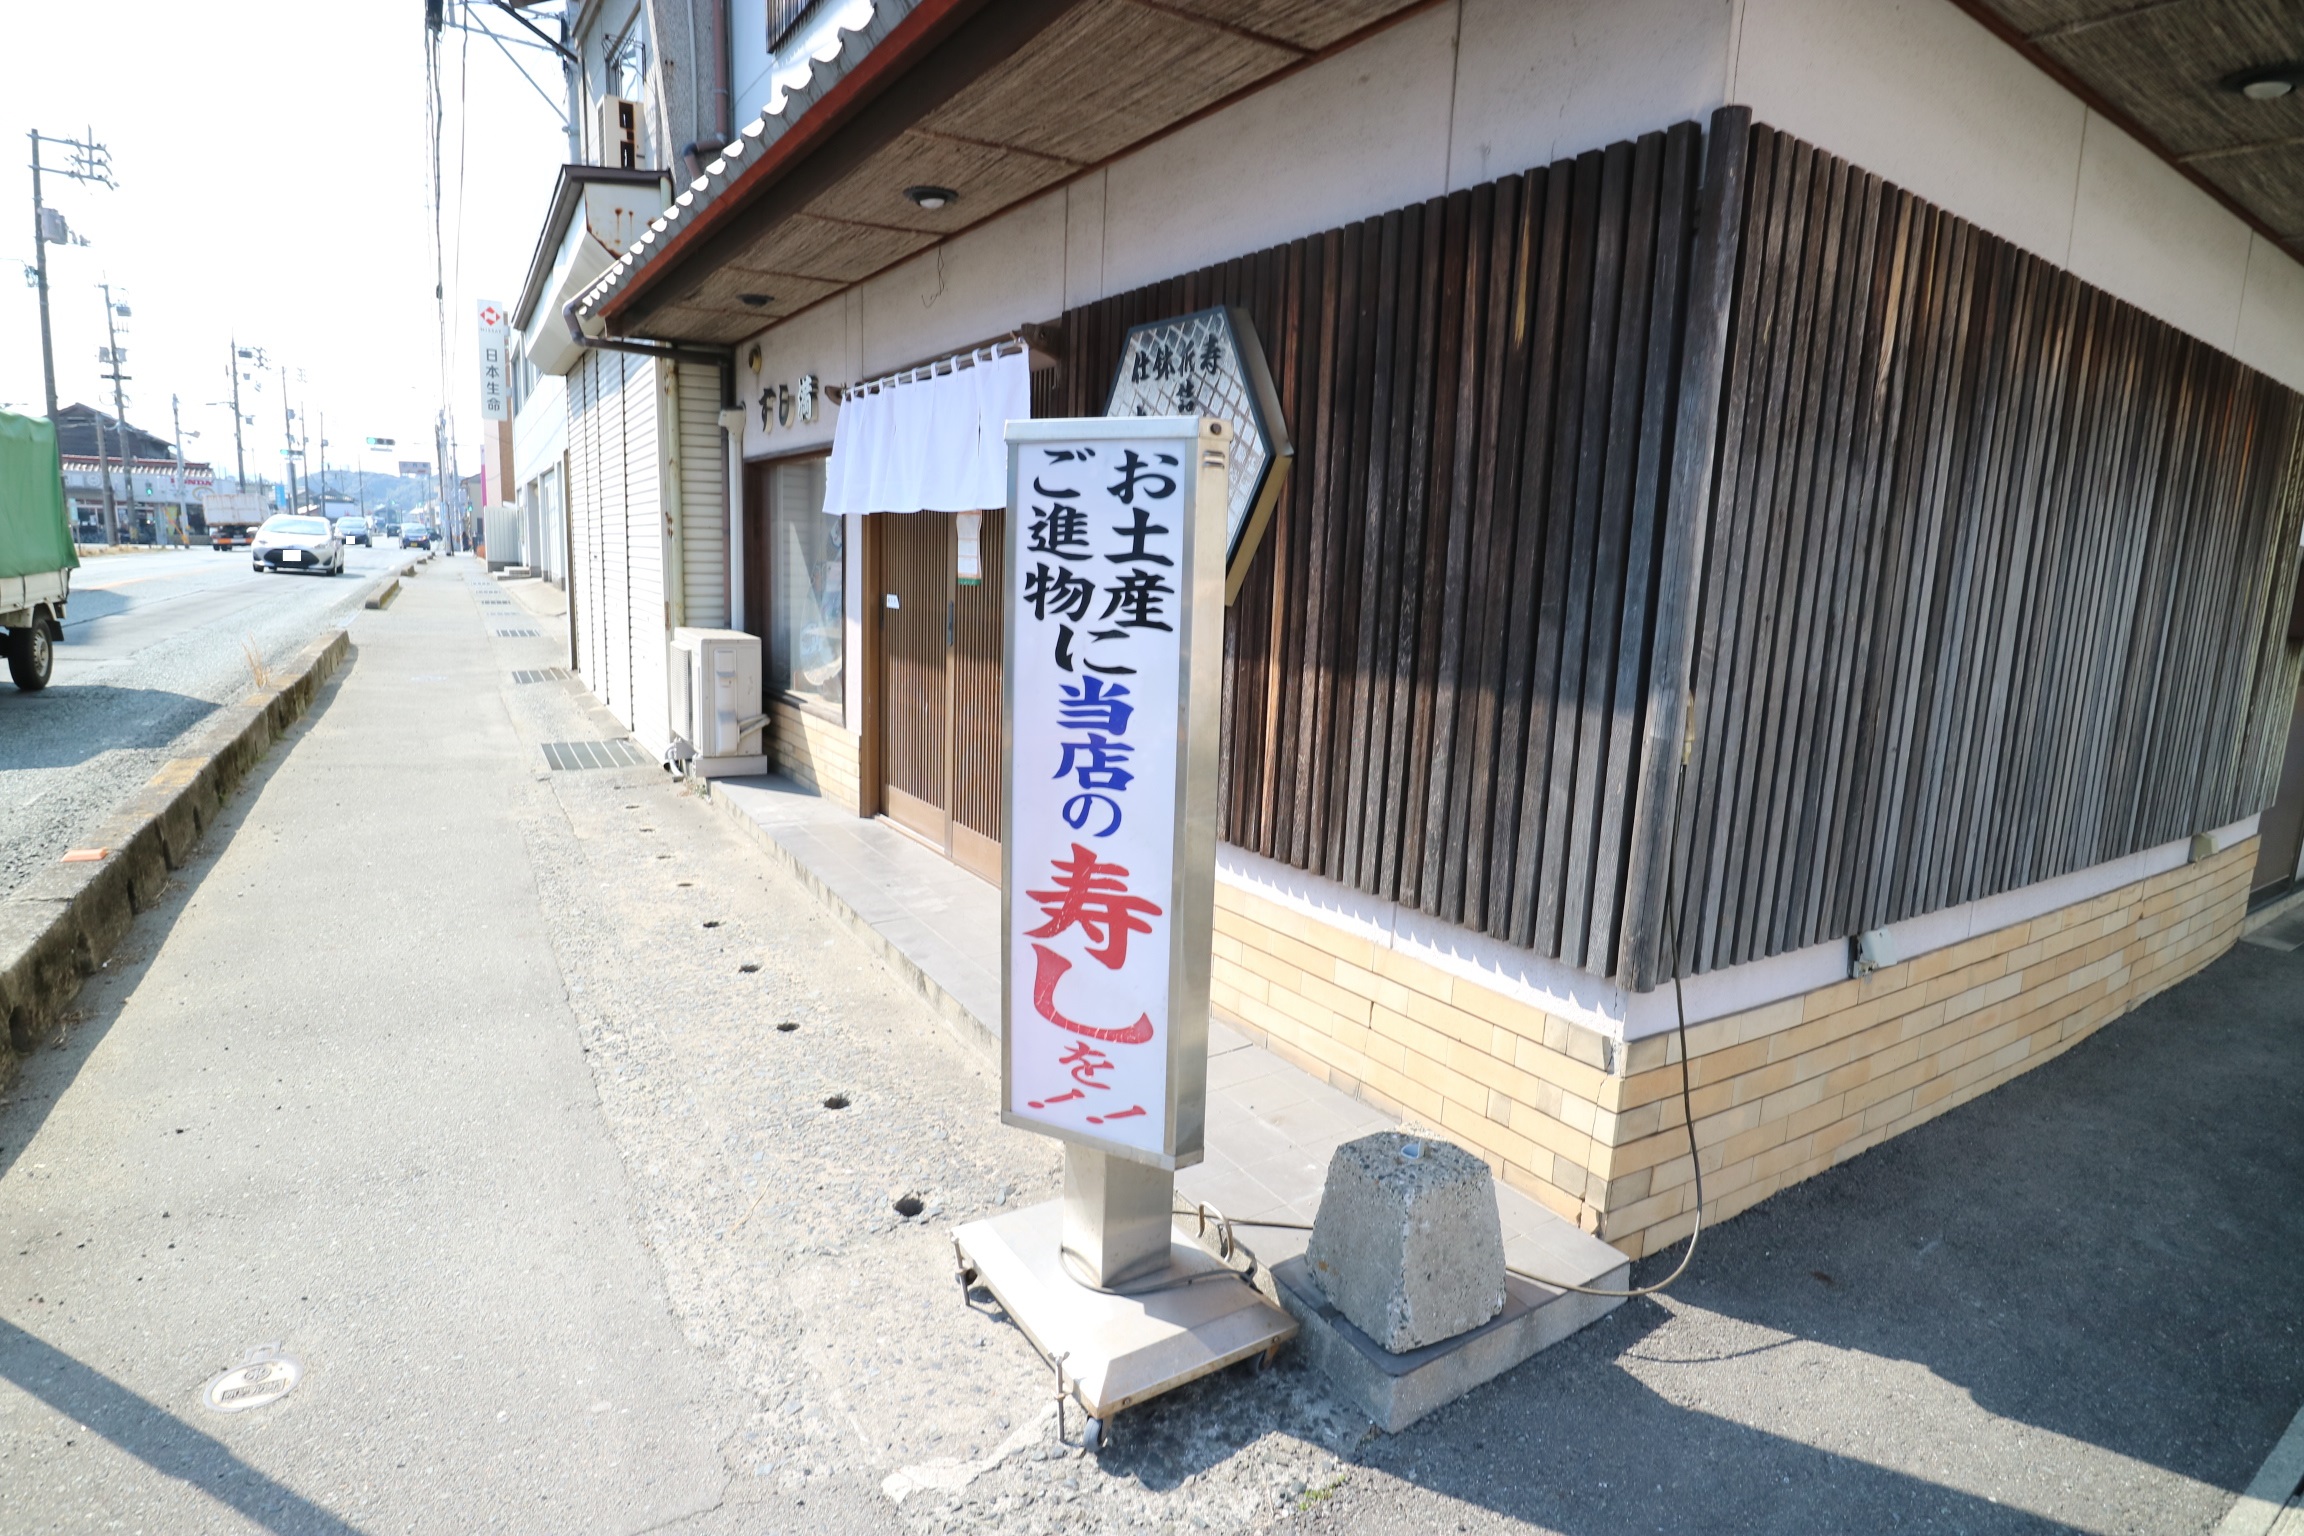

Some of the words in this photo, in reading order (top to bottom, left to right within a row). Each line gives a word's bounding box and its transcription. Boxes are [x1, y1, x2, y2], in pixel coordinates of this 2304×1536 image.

[486, 348, 501, 411] 日本生命
[1098, 448, 1180, 633] お土産
